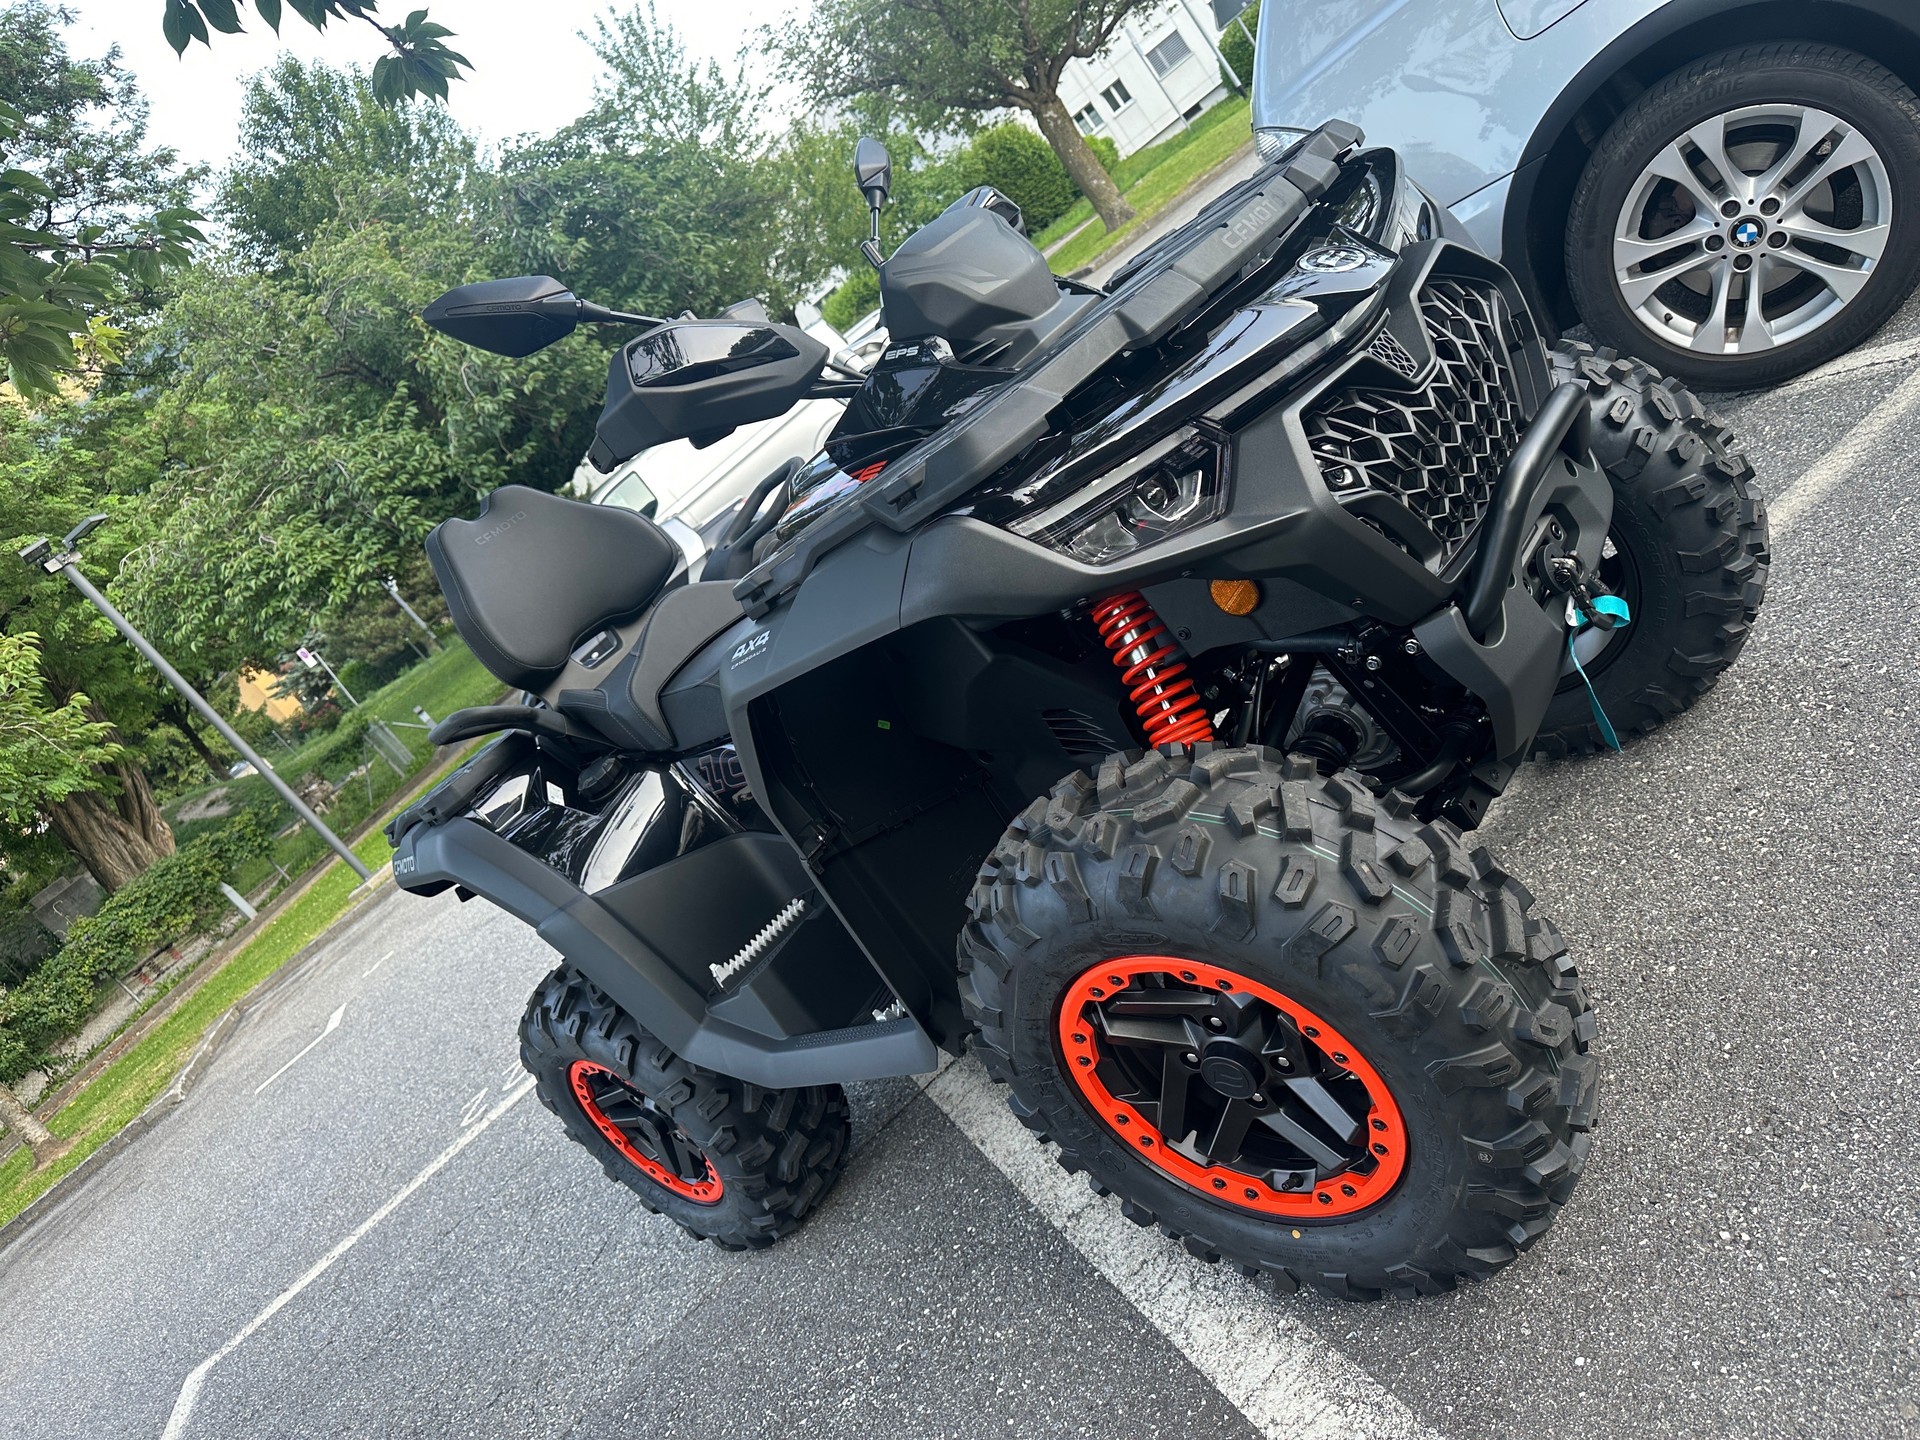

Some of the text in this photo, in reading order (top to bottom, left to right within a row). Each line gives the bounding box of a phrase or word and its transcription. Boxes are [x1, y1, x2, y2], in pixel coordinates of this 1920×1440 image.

[1221, 192, 1287, 249] CFMOTO
[486, 304, 522, 312] CFMOTO
[884, 346, 920, 361] EPS
[474, 510, 528, 546] CFMOTO
[394, 855, 415, 876] CFMOTO
